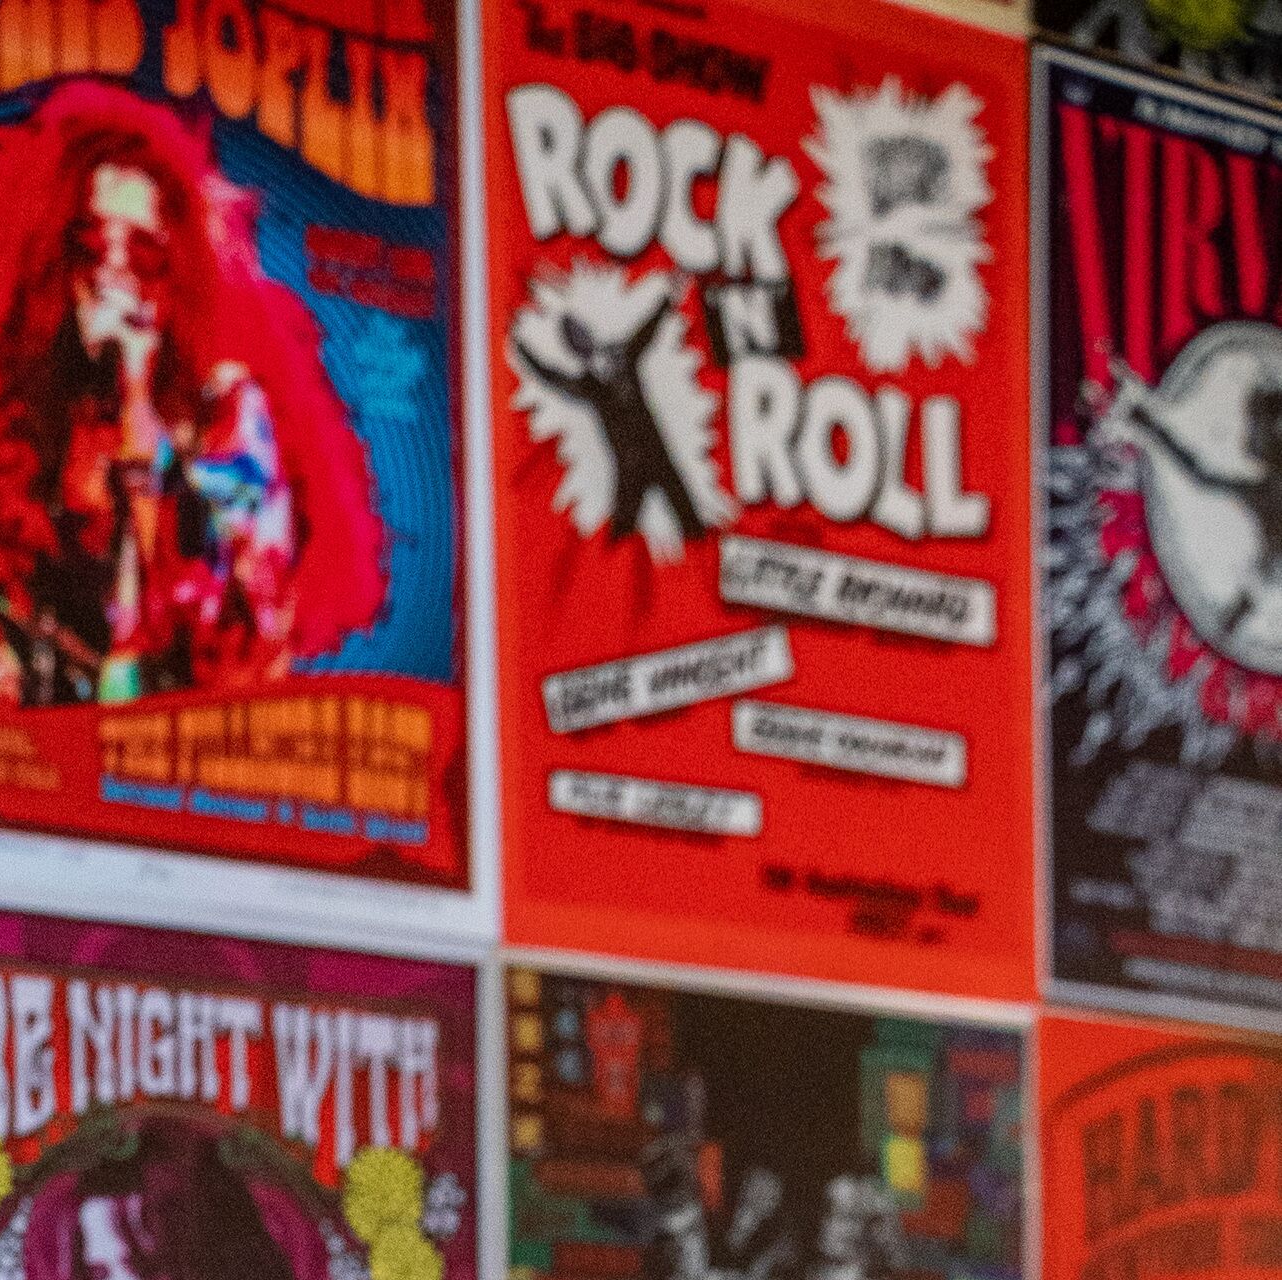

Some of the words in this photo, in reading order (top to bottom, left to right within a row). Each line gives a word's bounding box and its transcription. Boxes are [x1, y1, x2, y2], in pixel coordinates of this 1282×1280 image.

[505, 80, 802, 282] ROCK
[728, 355, 991, 540] ROLL
[70, 979, 263, 1117] NIGHT
[271, 1001, 441, 1168] WITH
